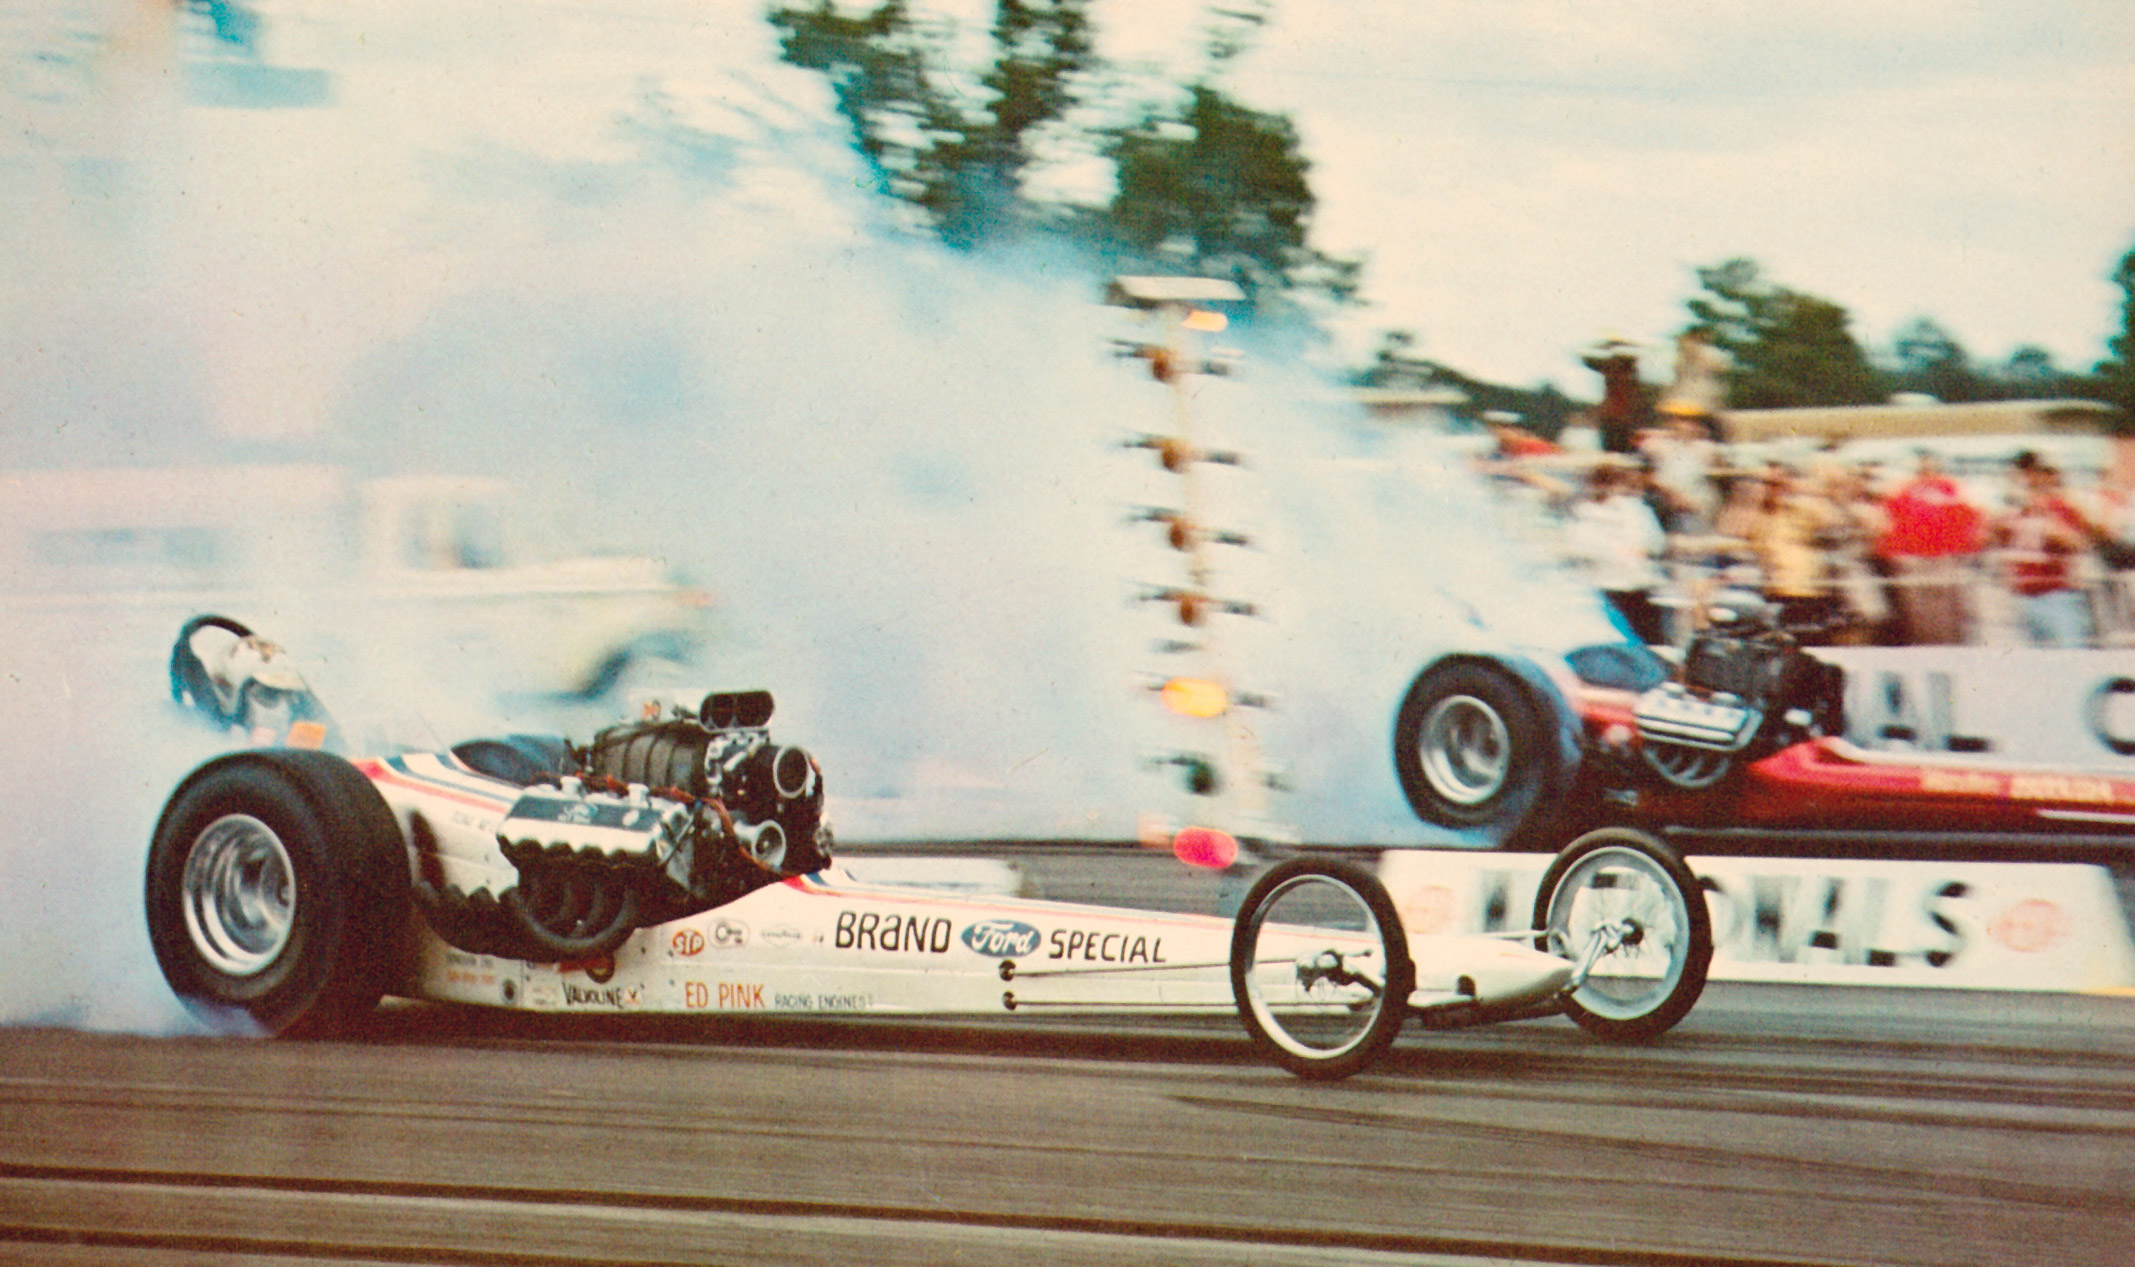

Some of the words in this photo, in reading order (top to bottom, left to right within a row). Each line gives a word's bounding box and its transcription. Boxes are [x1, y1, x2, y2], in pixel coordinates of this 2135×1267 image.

[673, 931, 704, 956] STP
[969, 921, 1035, 955] Ford
[1049, 929, 1168, 964] SPECIAL
[685, 981, 709, 1009] ED
[719, 981, 765, 1009] PINK
[775, 993, 813, 1010] RACING
